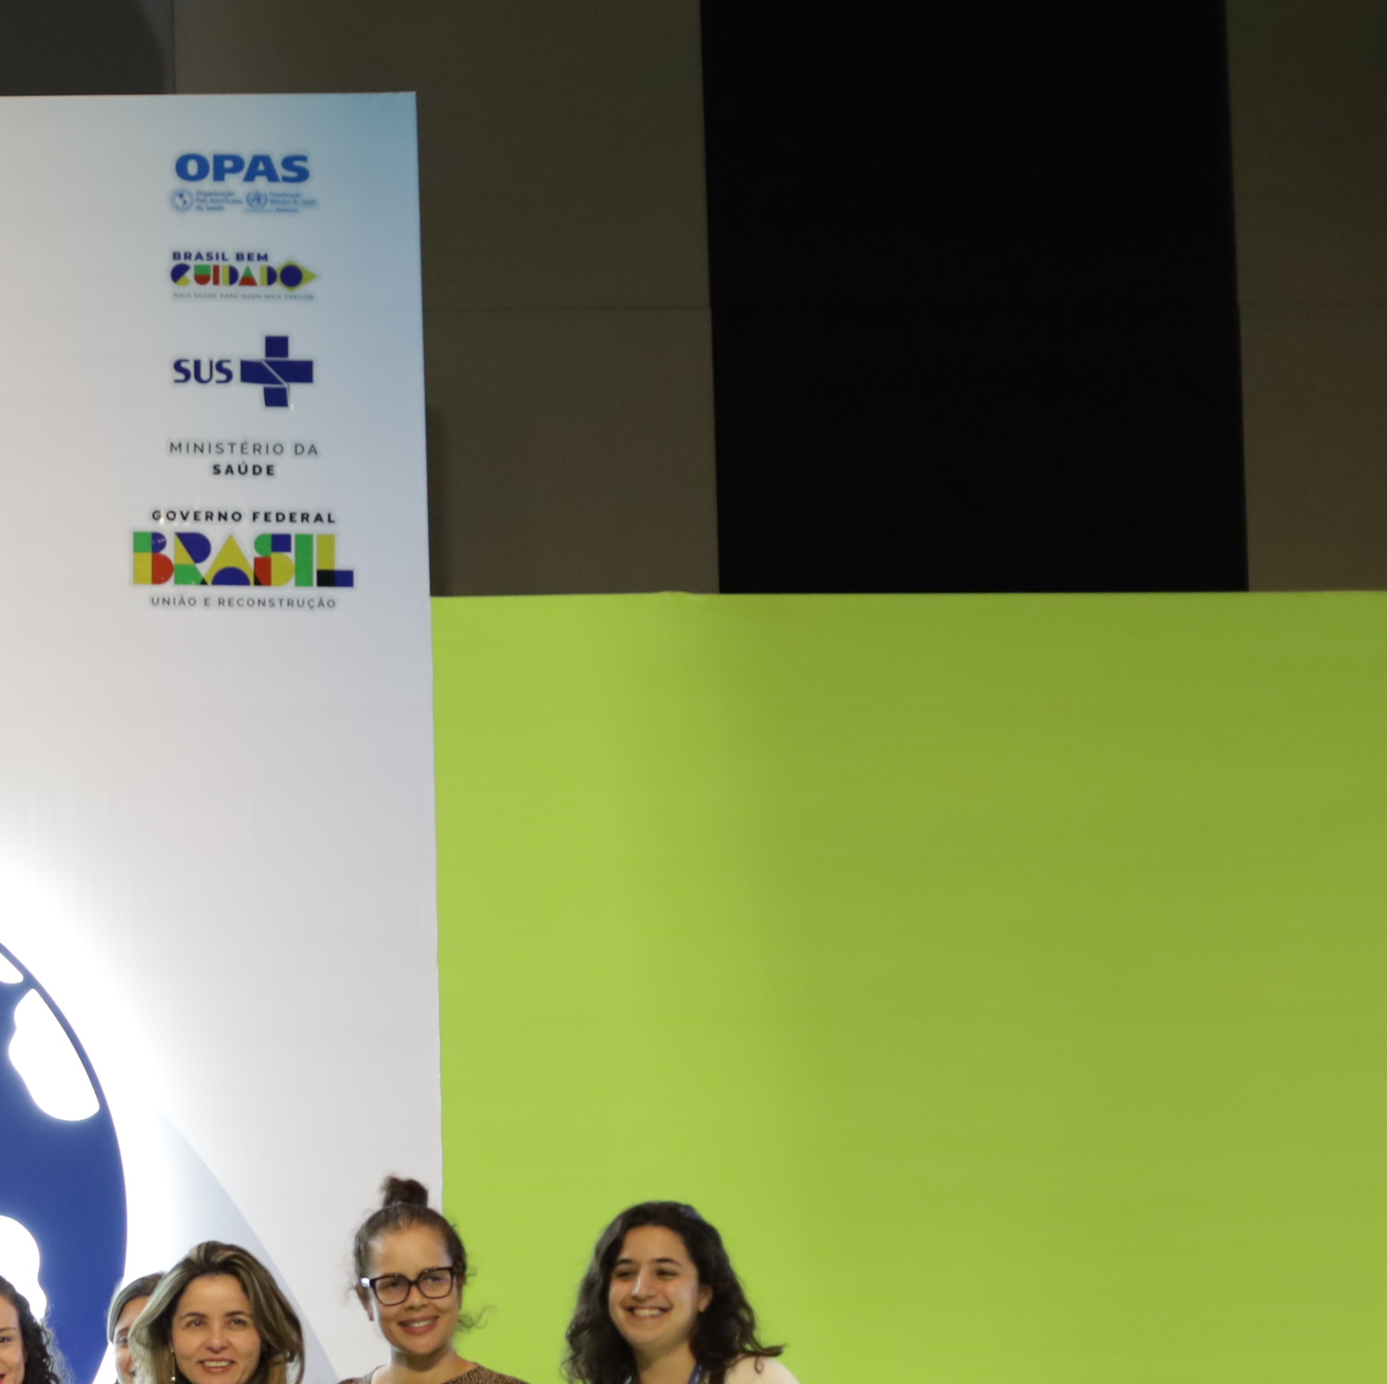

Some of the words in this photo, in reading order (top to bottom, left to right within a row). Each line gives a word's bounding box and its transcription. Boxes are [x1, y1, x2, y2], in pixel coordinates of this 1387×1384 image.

[175, 153, 310, 183] OPAS
[172, 252, 229, 262] BRASIL
[236, 252, 269, 262] BEM
[170, 262, 305, 288] CUIDADO
[172, 359, 234, 384] SUS
[169, 440, 284, 456] MINISTÉRIO
[294, 443, 318, 456] DA
[212, 461, 275, 476] SAÚDE
[151, 510, 243, 522] GOVERNO
[252, 511, 336, 523] FEDERAL
[133, 531, 354, 587] BRASIL
[151, 595, 197, 607] UNIÃO
[203, 597, 211, 606] E
[217, 597, 336, 609] RECONSTRUÇÃO
